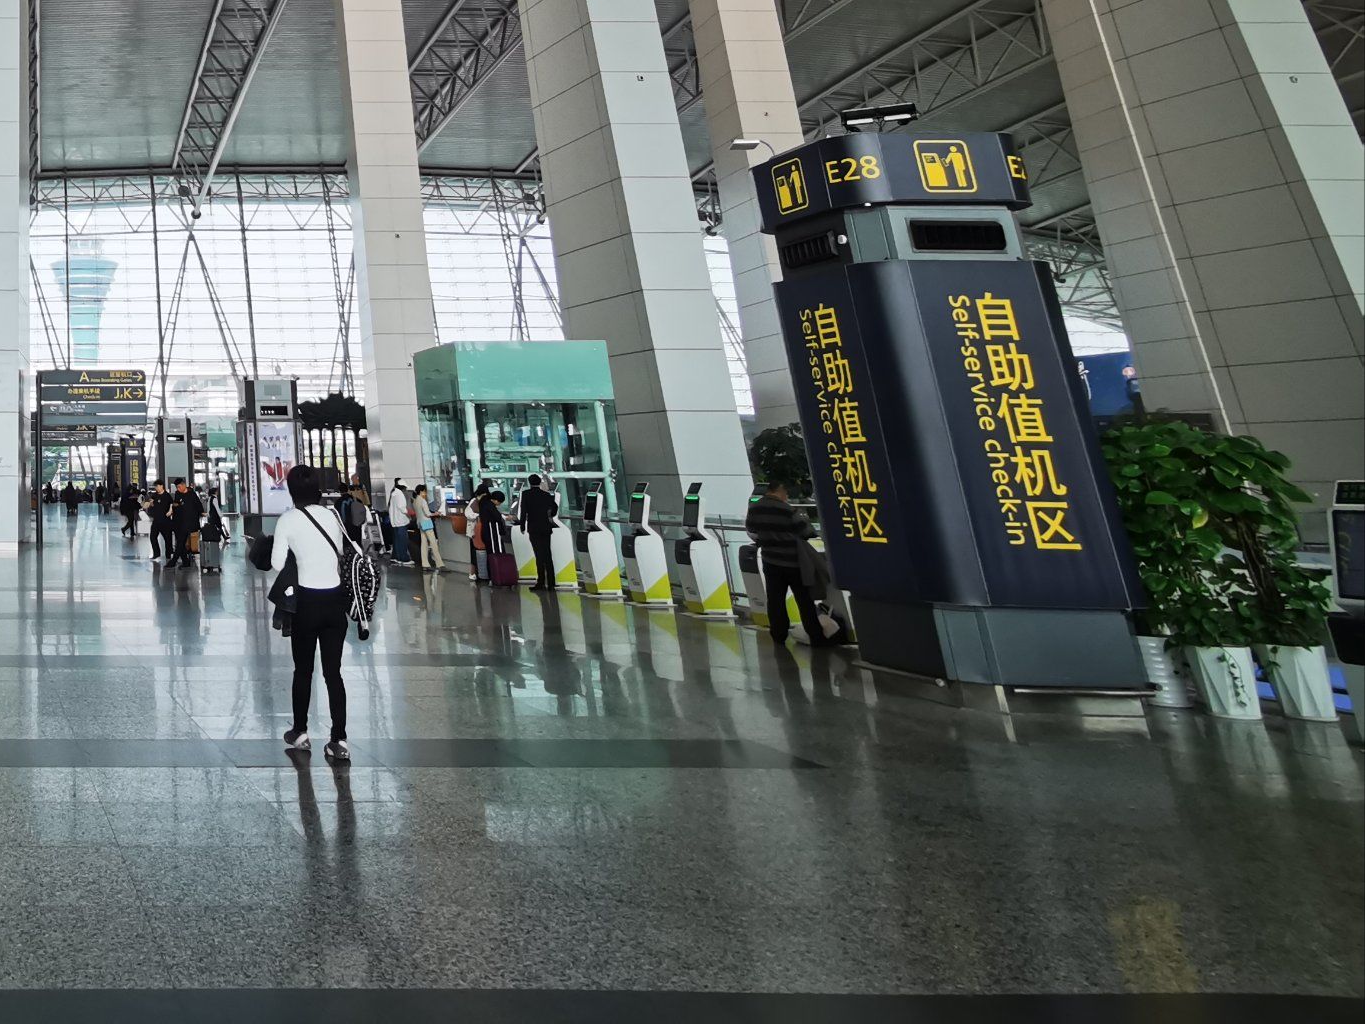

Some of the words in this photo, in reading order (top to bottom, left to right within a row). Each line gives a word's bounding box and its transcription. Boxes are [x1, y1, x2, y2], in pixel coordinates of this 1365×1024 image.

[825, 155, 881, 184] E28
[79, 371, 89, 382] A
[799, 308, 834, 434] Self-service
[827, 442, 855, 538] check-in
[814, 302, 888, 544] 自助值机区
[948, 294, 996, 431] Self-service
[985, 439, 1028, 545] check-in
[975, 292, 1082, 550] 自助值机区
